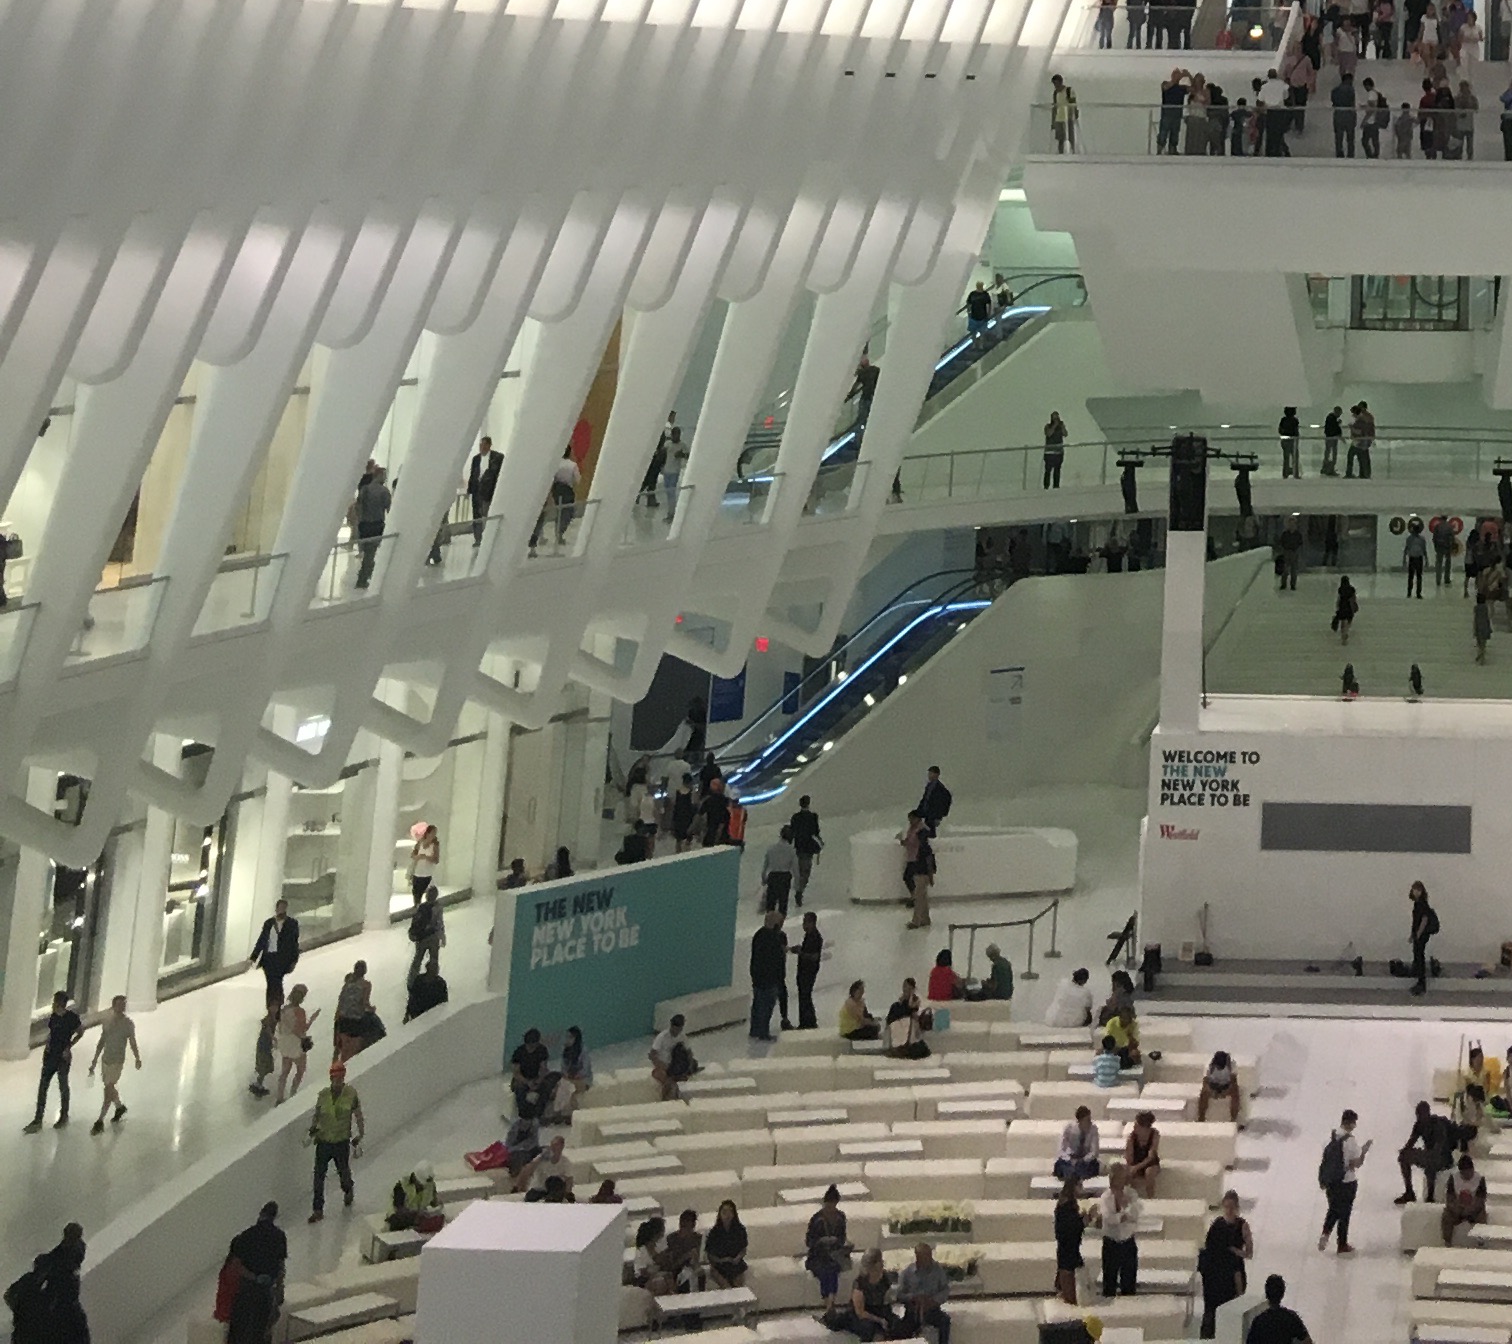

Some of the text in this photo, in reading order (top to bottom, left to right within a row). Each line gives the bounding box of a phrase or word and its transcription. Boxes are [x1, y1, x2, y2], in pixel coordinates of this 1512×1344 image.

[1162, 750, 1260, 765] WELCOME TO
[1162, 764, 1227, 778] THE NEW
[1161, 778, 1240, 793] NEW YORK
[1160, 792, 1250, 807] PLACE TO BE
[535, 886, 615, 922] THE NEW
[532, 905, 627, 944] NEW YORK
[530, 923, 640, 971] PLACE TO BE
